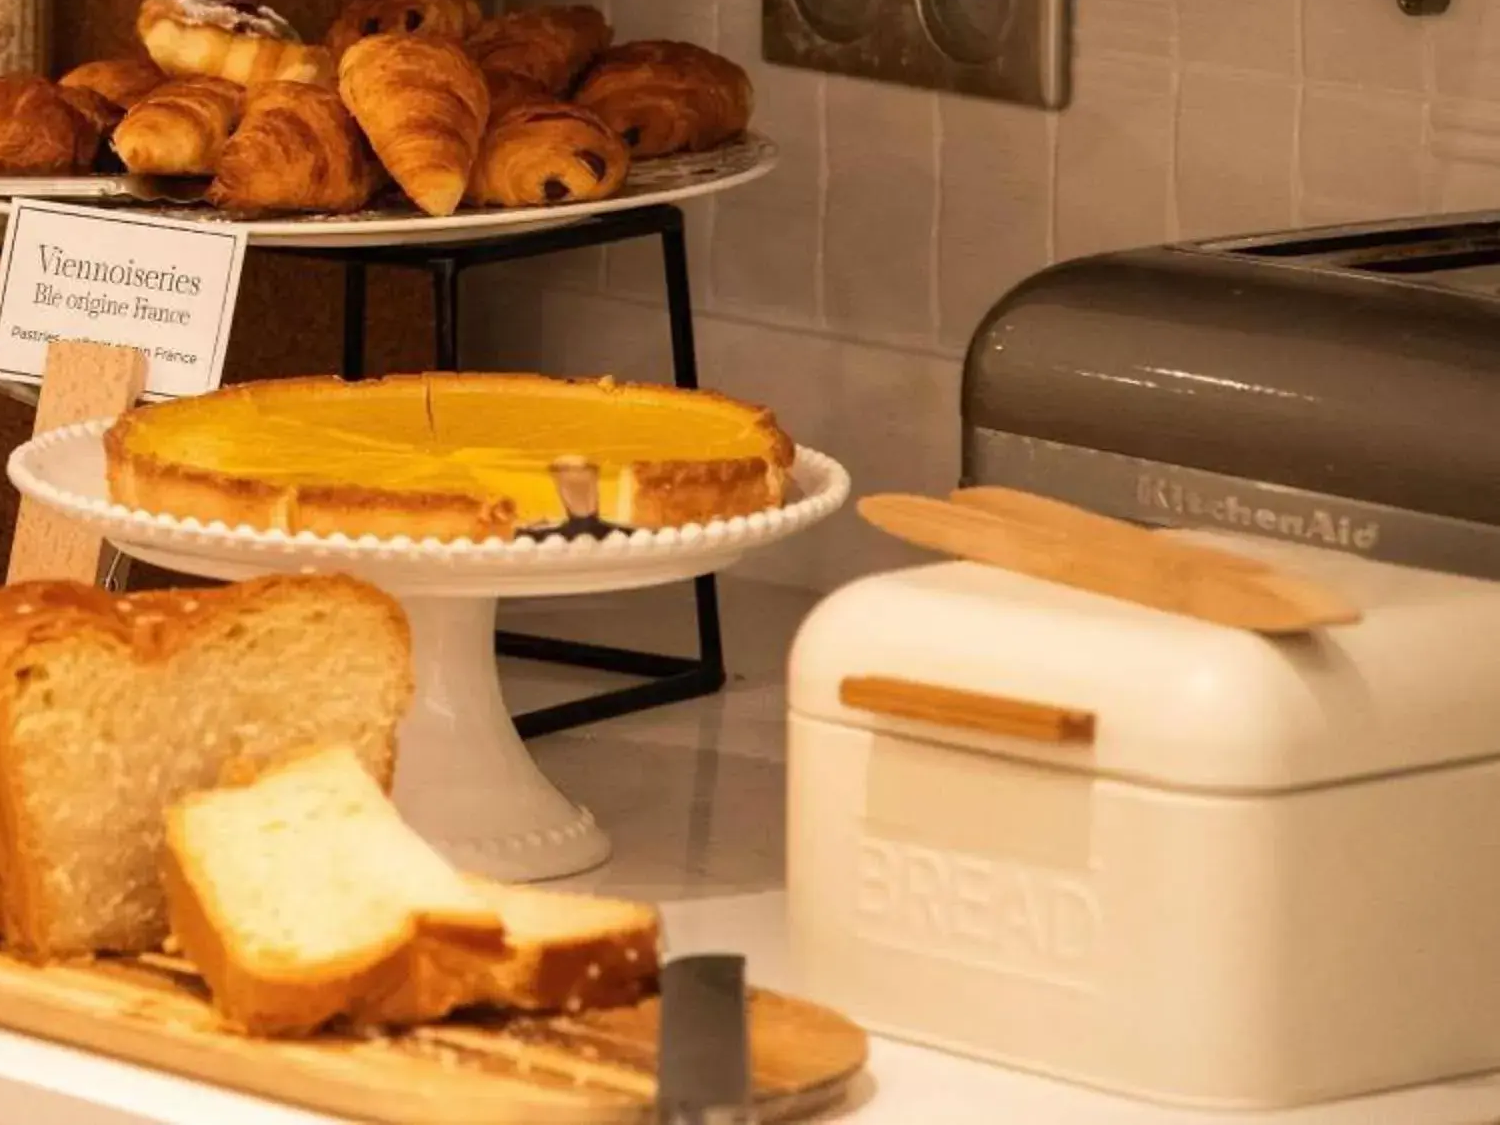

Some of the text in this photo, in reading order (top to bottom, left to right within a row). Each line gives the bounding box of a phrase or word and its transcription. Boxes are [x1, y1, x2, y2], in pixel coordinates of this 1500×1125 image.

[38, 244, 202, 296] Viennoiseries
[65, 291, 129, 320] origine
[133, 296, 192, 326] France
[11, 325, 60, 344] Pastries
[154, 346, 198, 365] France
[1137, 475, 1380, 550] KitchenAid
[854, 840, 1104, 959] BREAD
